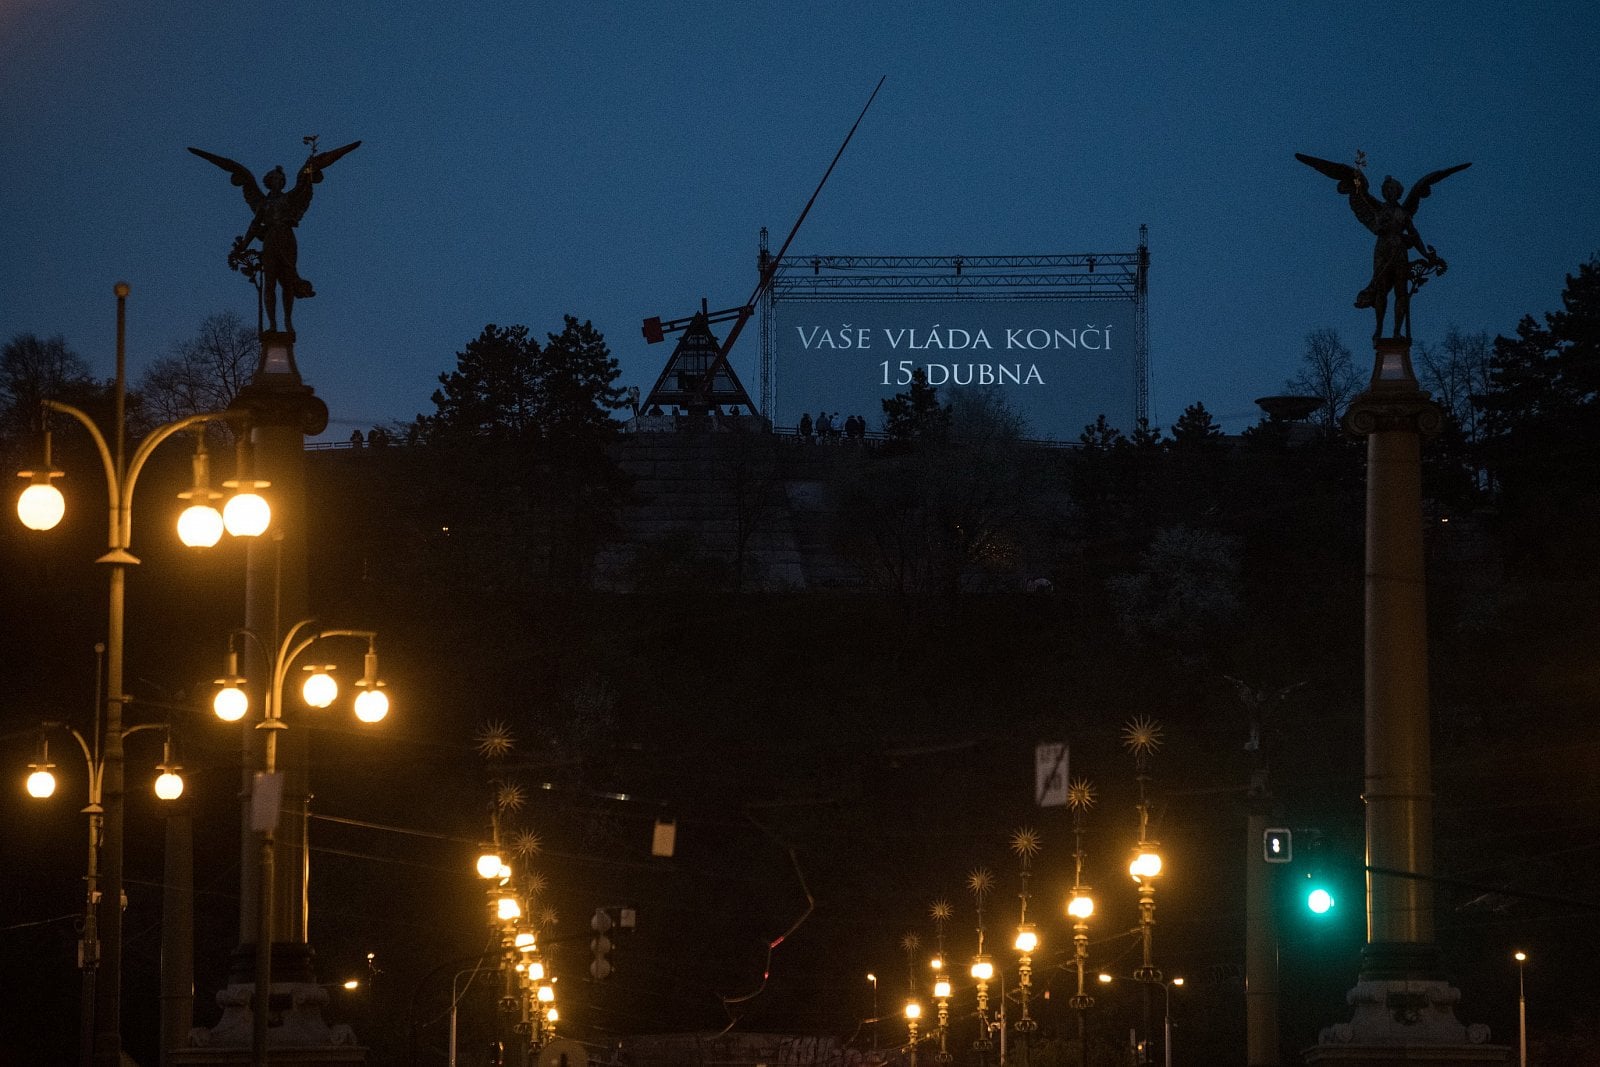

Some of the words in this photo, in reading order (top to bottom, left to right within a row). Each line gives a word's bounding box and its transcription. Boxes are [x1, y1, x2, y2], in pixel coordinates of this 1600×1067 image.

[795, 323, 871, 350] VAŠE
[882, 322, 994, 350] VLÁDA
[1005, 322, 1113, 351] KONČÍ
[879, 360, 913, 386] 15
[925, 363, 1046, 386] DUBNA
